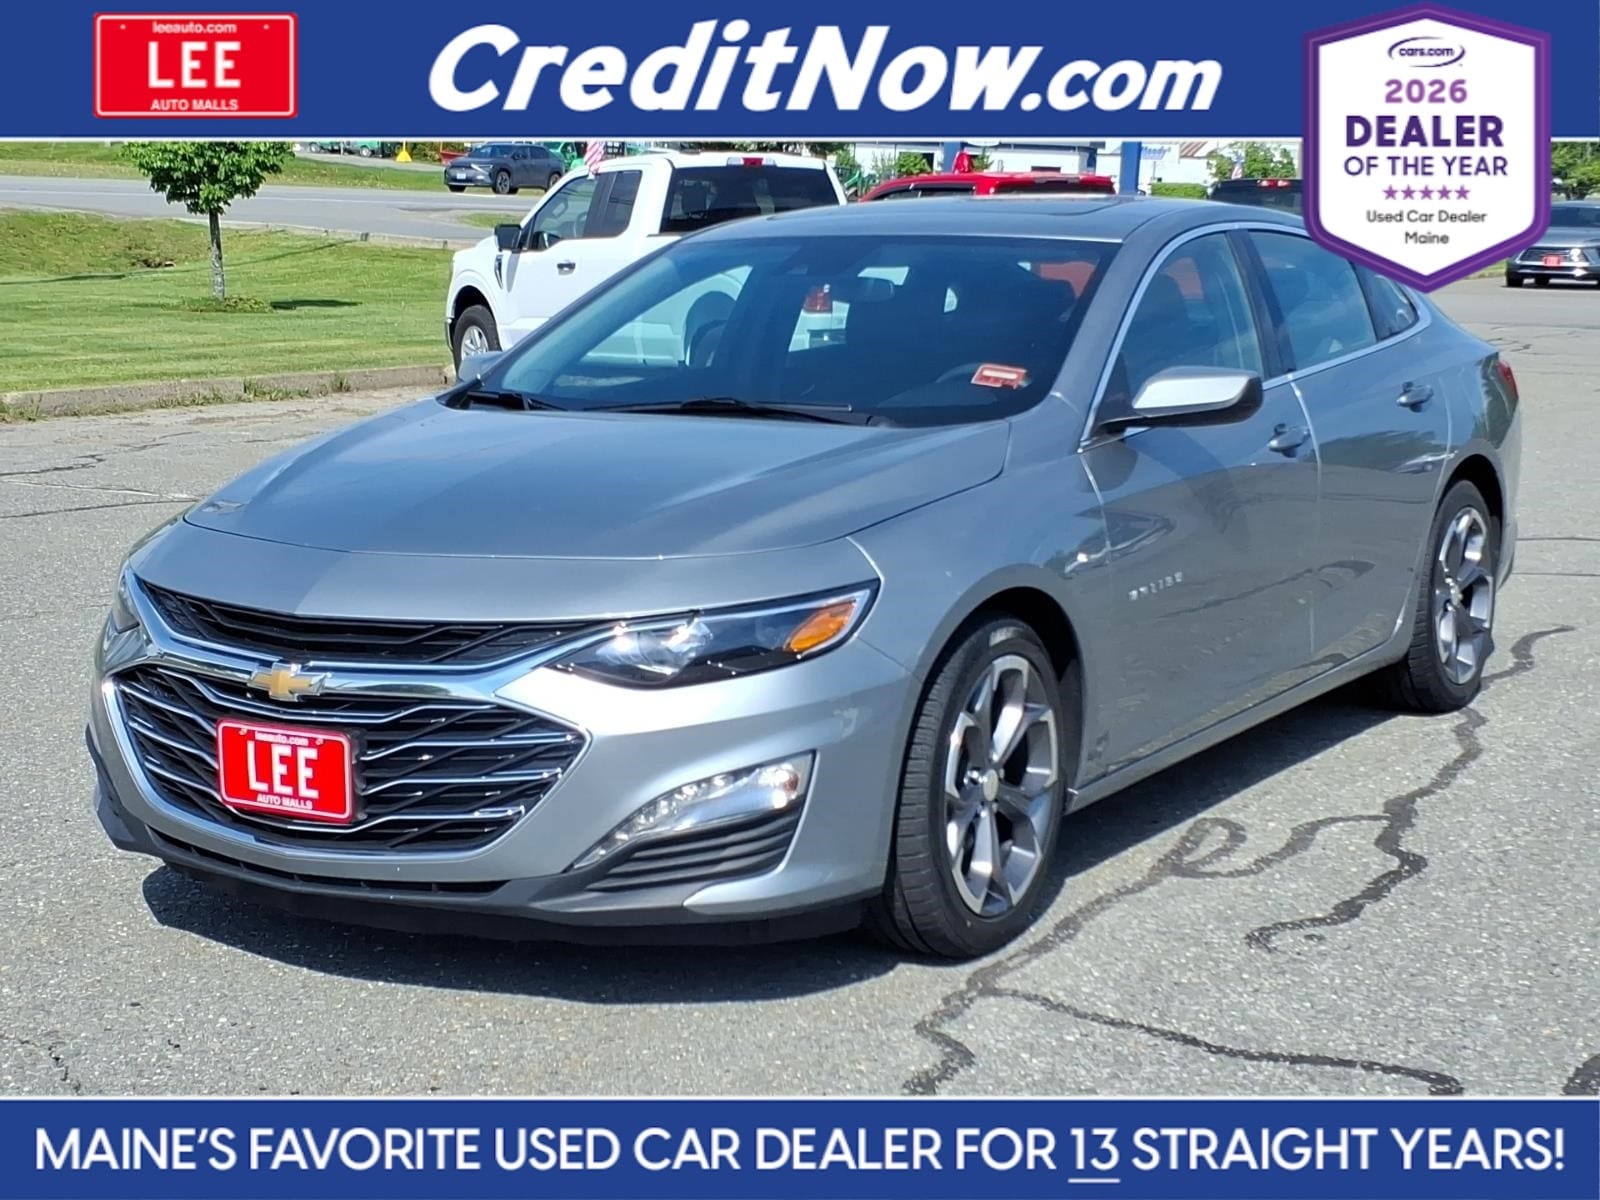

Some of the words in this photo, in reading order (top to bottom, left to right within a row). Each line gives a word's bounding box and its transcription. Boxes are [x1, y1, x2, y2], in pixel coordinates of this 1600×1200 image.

[247, 740, 319, 799] LEE
[256, 793, 281, 806] AUTO
[282, 798, 313, 810] MALLS
